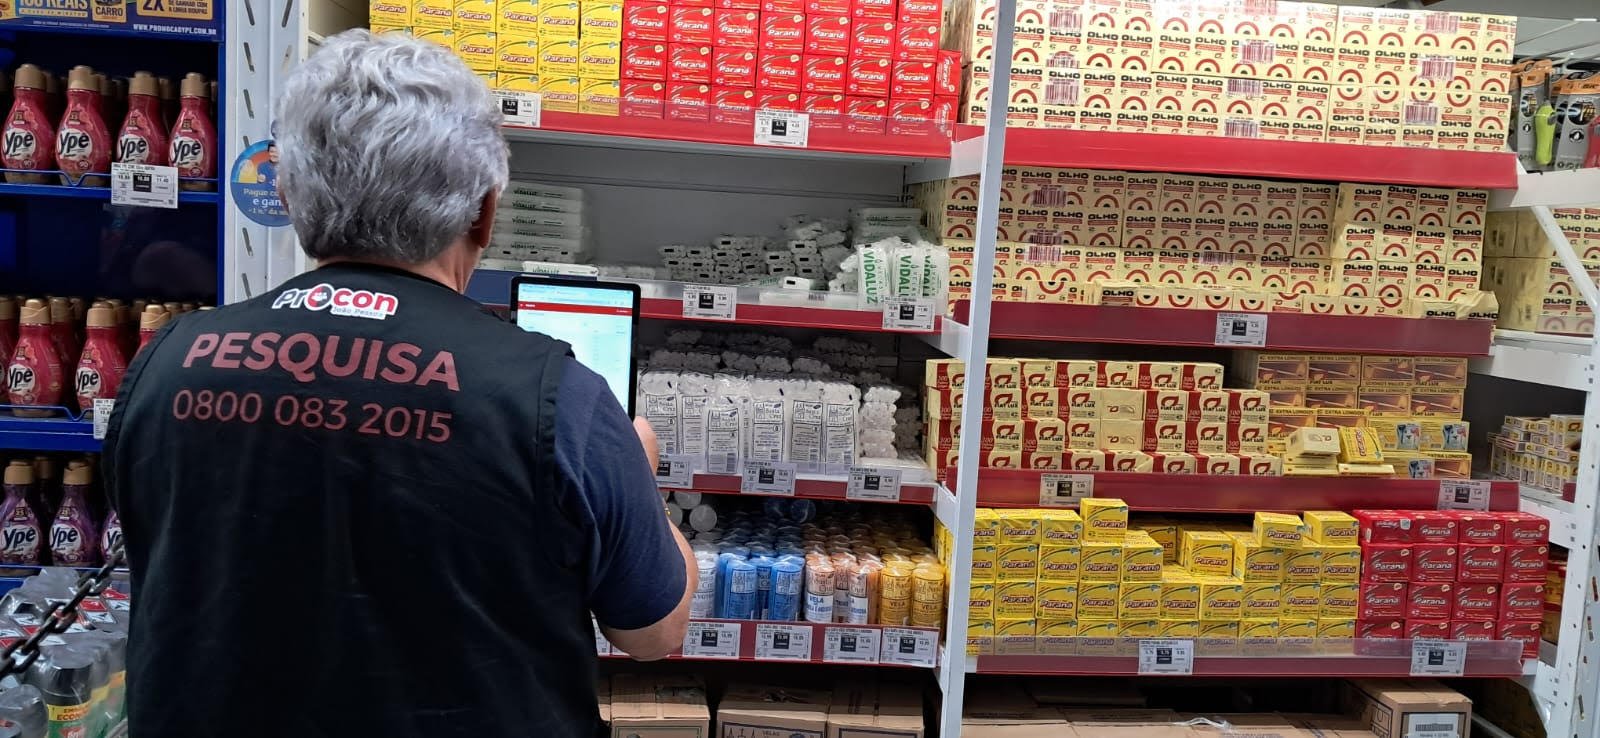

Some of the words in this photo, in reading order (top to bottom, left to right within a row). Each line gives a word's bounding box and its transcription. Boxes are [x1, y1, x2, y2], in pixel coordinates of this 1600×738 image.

[1087, 32, 1118, 40] OLHO
[1122, 35, 1152, 43] OLHO
[1195, 37, 1226, 45] OLHO
[1339, 48, 1369, 56] OLHO
[1482, 57, 1512, 65] OLHO
[1011, 67, 1042, 75] OLHO
[1084, 73, 1115, 81] OLHO
[1192, 77, 1223, 86] OLHO
[1152, 113, 1182, 121] OLHO
[1260, 121, 1289, 129] OLHO
[1329, 125, 1360, 133] OLHO
[1366, 128, 1396, 136] OLHO
[1021, 171, 1052, 179] OLHO
[1389, 186, 1417, 194] OLHO
[1457, 191, 1486, 199] OLHO
[1053, 211, 1083, 219] OLHO
[863, 251, 878, 304] VIDALUZ
[898, 255, 912, 297] VIDAL
[182, 332, 460, 392] PESQUISA
[172, 389, 263, 423] 0800
[274, 394, 348, 430] 083
[358, 403, 453, 443] 2015
